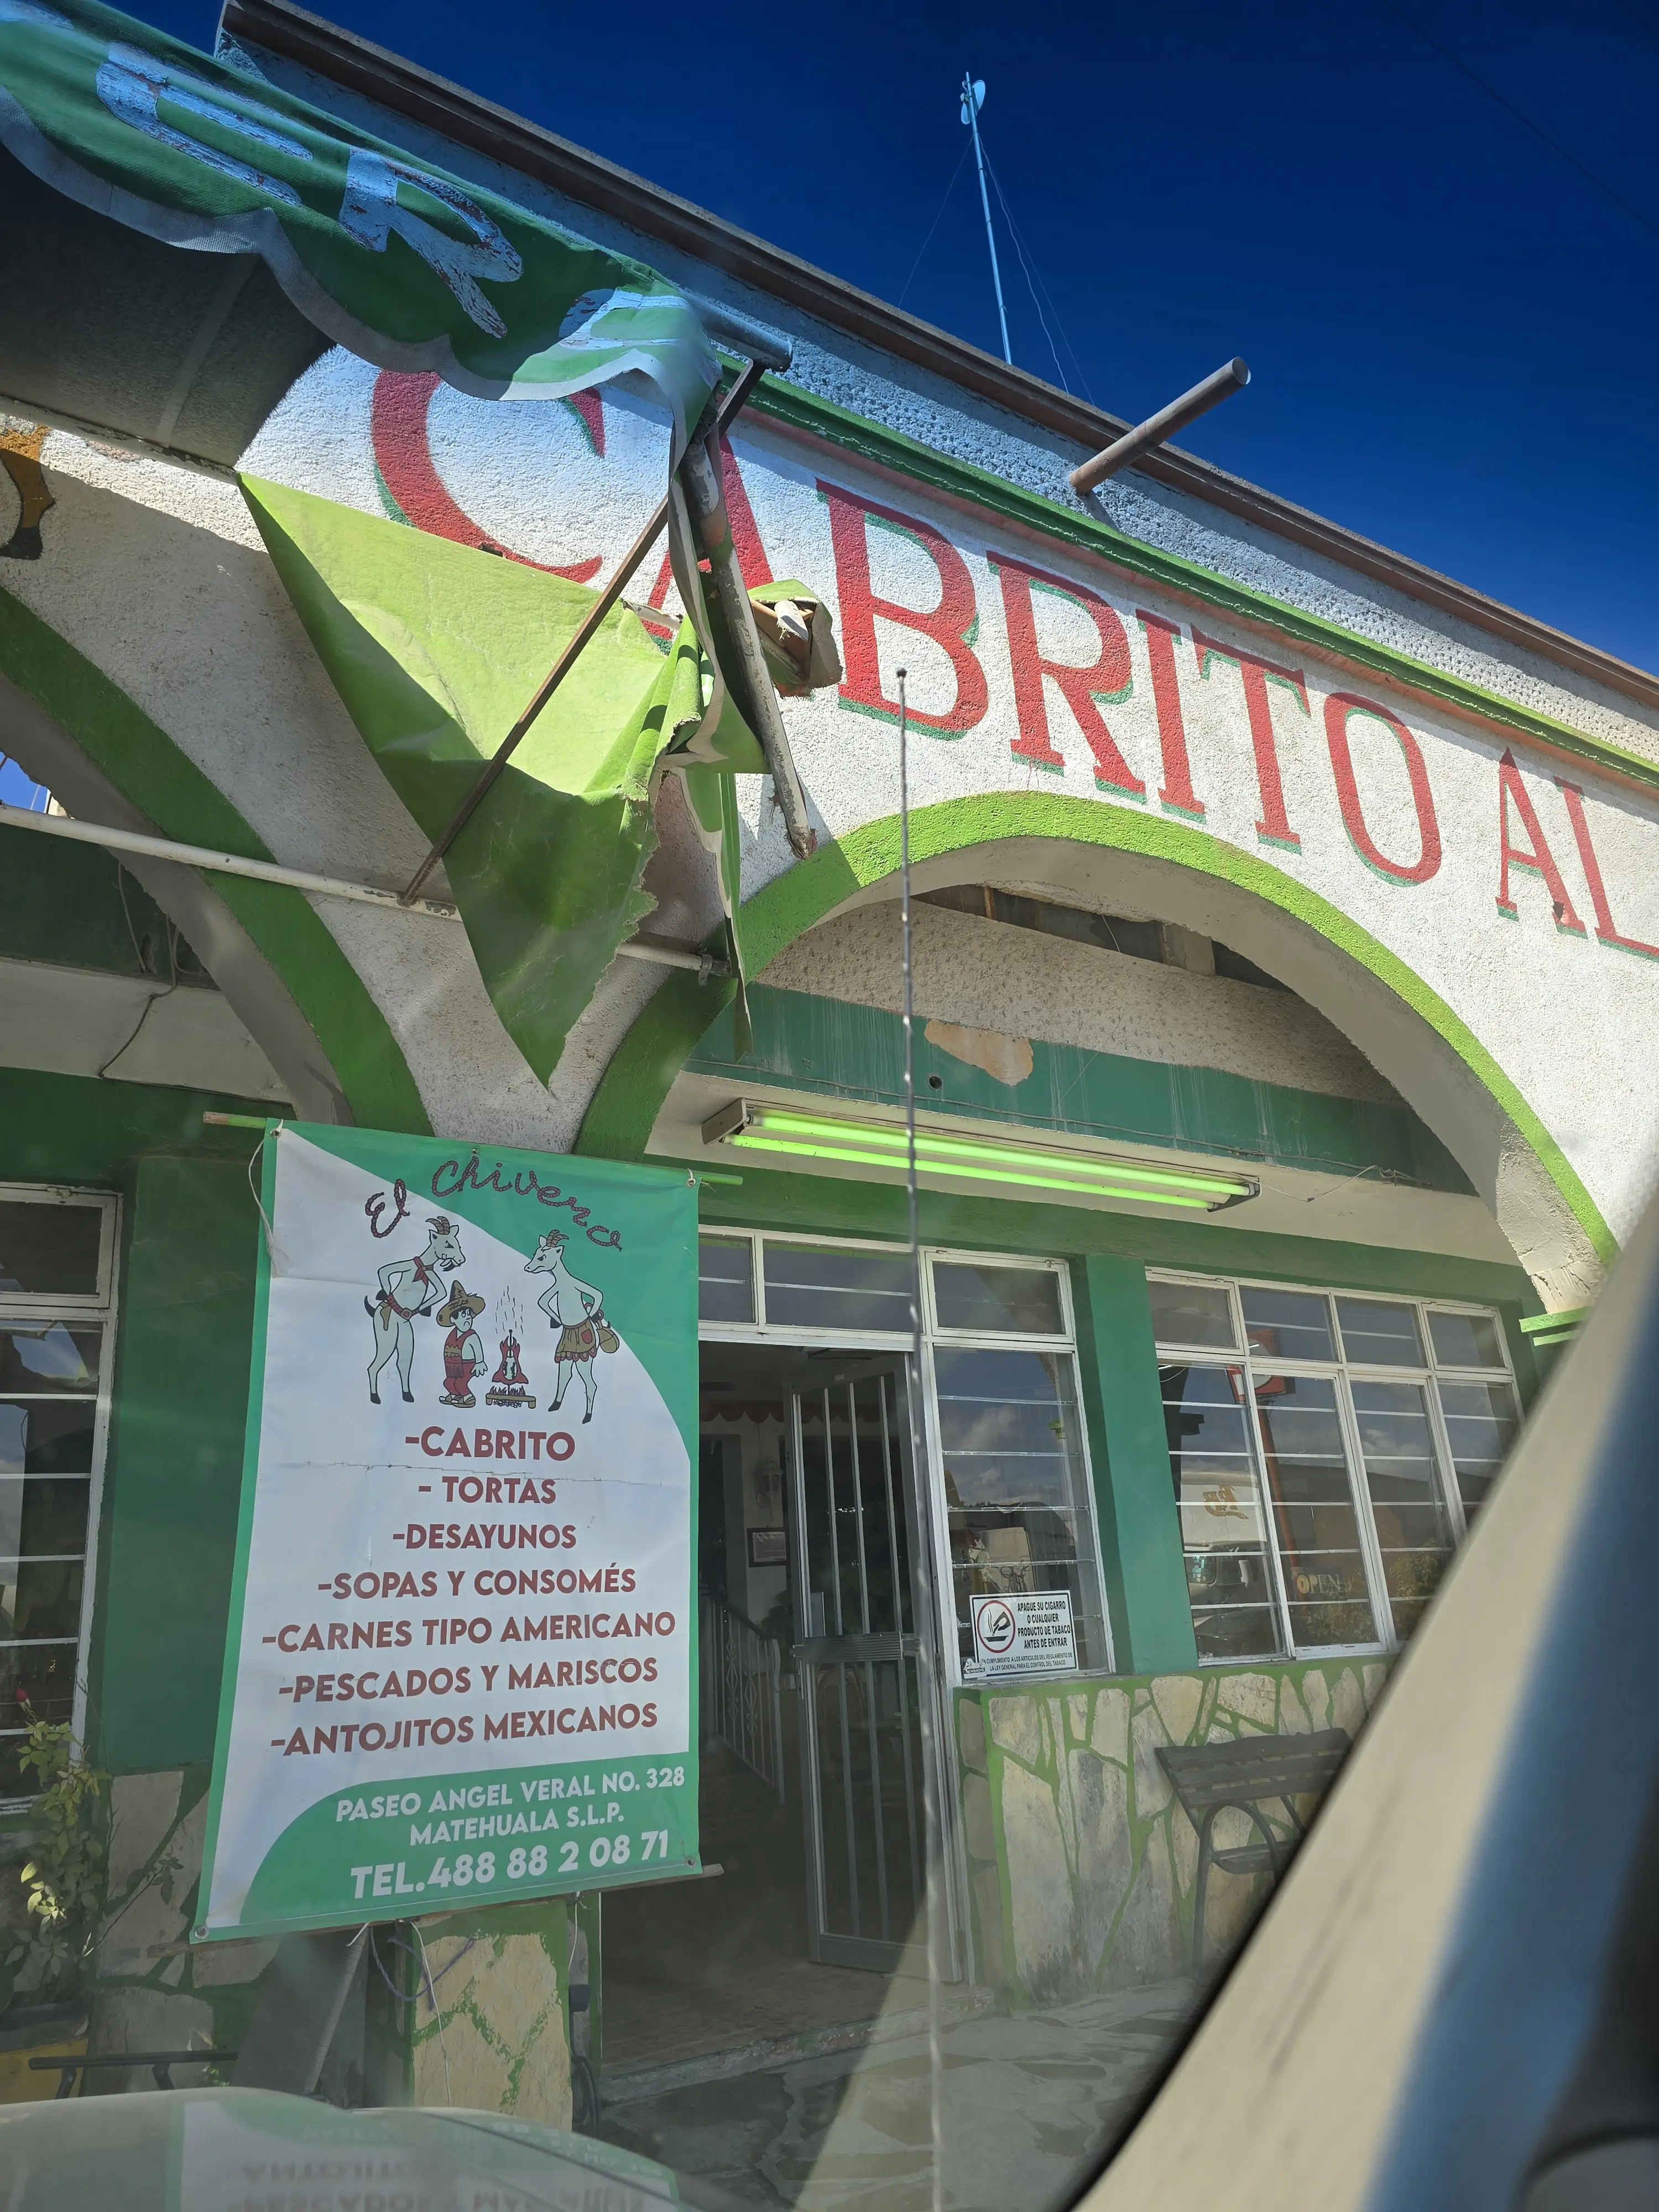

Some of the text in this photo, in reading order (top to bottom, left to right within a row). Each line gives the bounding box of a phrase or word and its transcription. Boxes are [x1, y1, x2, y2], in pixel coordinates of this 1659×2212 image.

[1495, 747, 1659, 958] AL
[365, 1178, 411, 1238] El
[405, 1426, 575, 1460] -CABRITO
[443, 1476, 556, 1503] TORTAS
[393, 1524, 576, 1549] -DESAYUNOS
[318, 1562, 636, 1599] -SOPAS Y CONSOMÉS
[1297, 1574, 1340, 1594] OPEN
[1018, 1600, 1066, 1612] APAGUE SU CIGARRO
[1027, 1613, 1059, 1624] O CUALQUIER
[263, 1611, 675, 1652] -CARNES TIPO AMERICANO
[1018, 1625, 1071, 1637] PRODUCTO DE TABACO
[1024, 1637, 1067, 1649] ANTES DE ENTRAR
[279, 1658, 658, 1702] -PESCADOS Y MARISCOS
[271, 1703, 658, 1756] -ANTOJITOS MEXICANOS
[336, 1766, 685, 1822] PASEO ANGEL VERAL NO. 328
[410, 1802, 624, 1846] MATEHUALA S.L.P.
[351, 1829, 668, 1899] TEL.488 88 2 08 71
